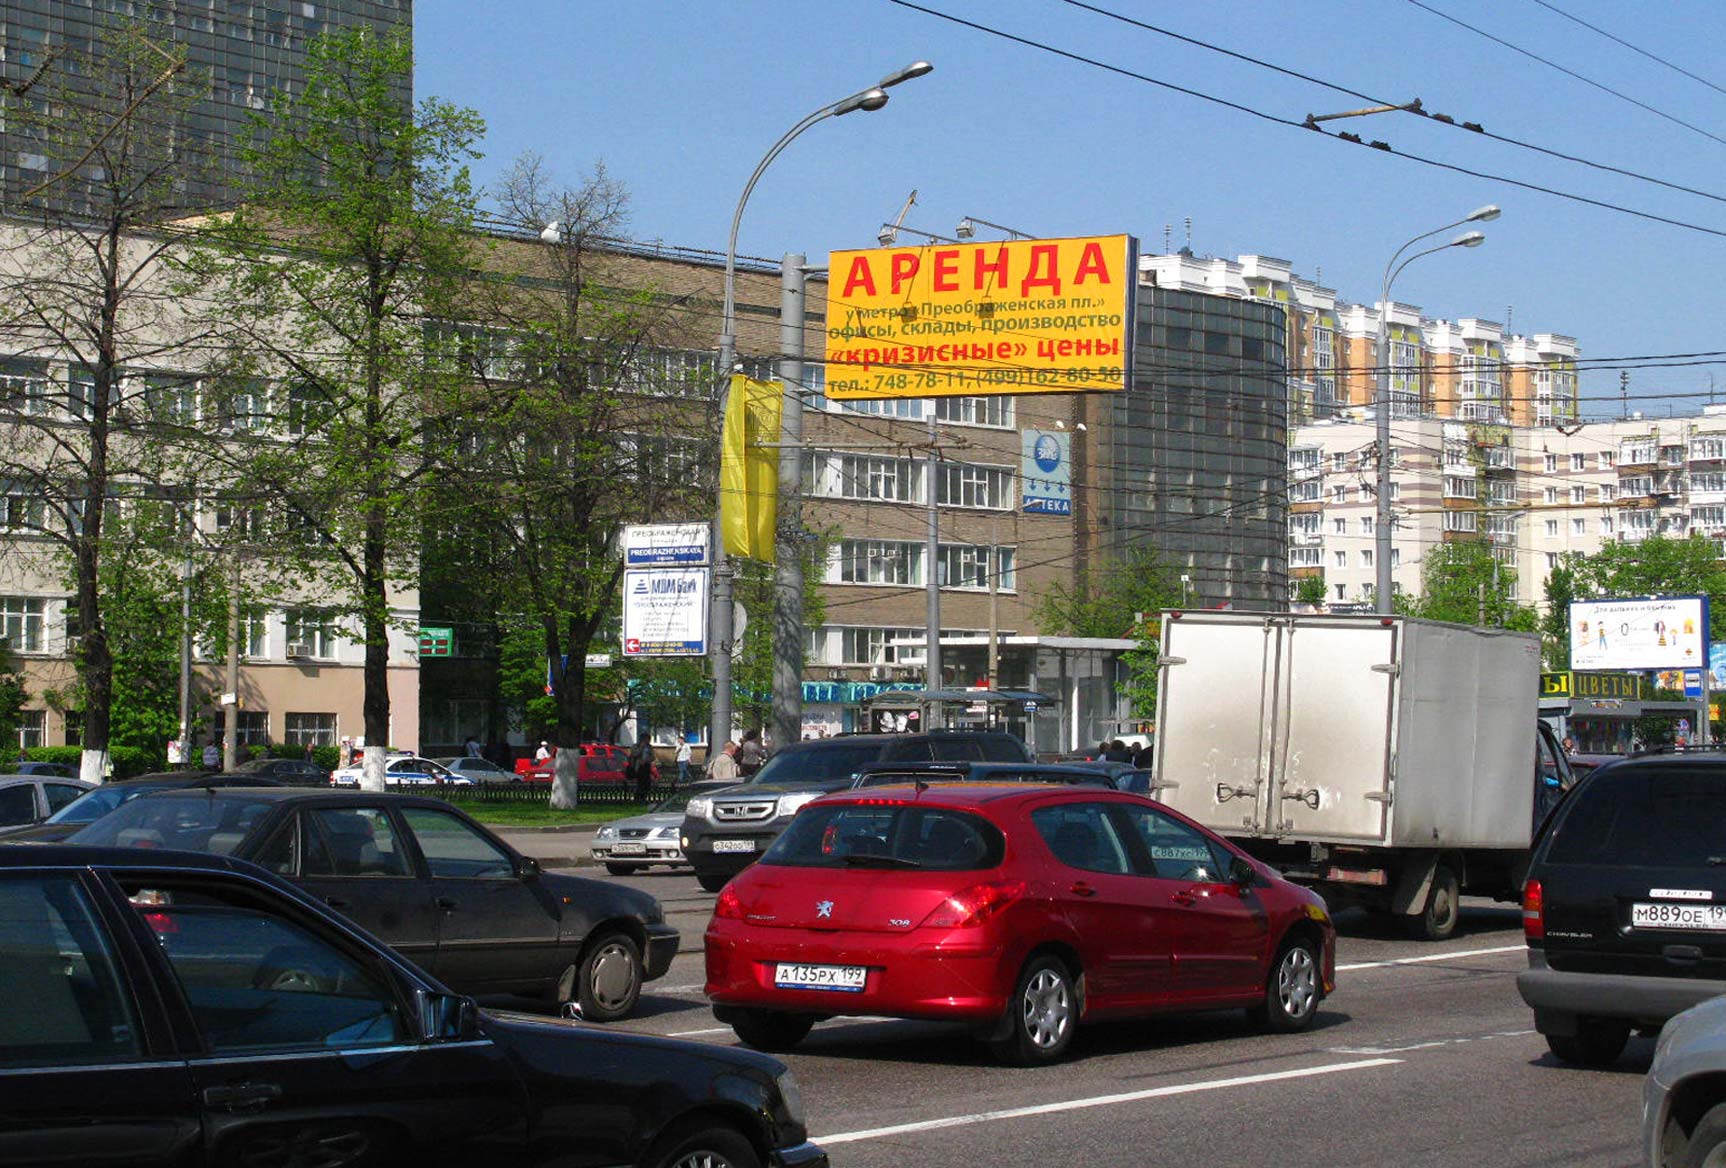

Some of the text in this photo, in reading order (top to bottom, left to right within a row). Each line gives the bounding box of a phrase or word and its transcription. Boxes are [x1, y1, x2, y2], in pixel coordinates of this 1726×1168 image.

[842, 242, 1111, 298] АРЕНДА
[901, 319, 976, 337] склады,
[981, 314, 1121, 335] производство
[831, 337, 1119, 372] «кризисные» цены
[874, 371, 972, 390] 748-78-11,
[1026, 497, 1069, 512] АТЕКА
[1578, 675, 1632, 695] ЦВЕТЫ
[1708, 906, 1726, 919] 19
[780, 966, 836, 982] А135РХ
